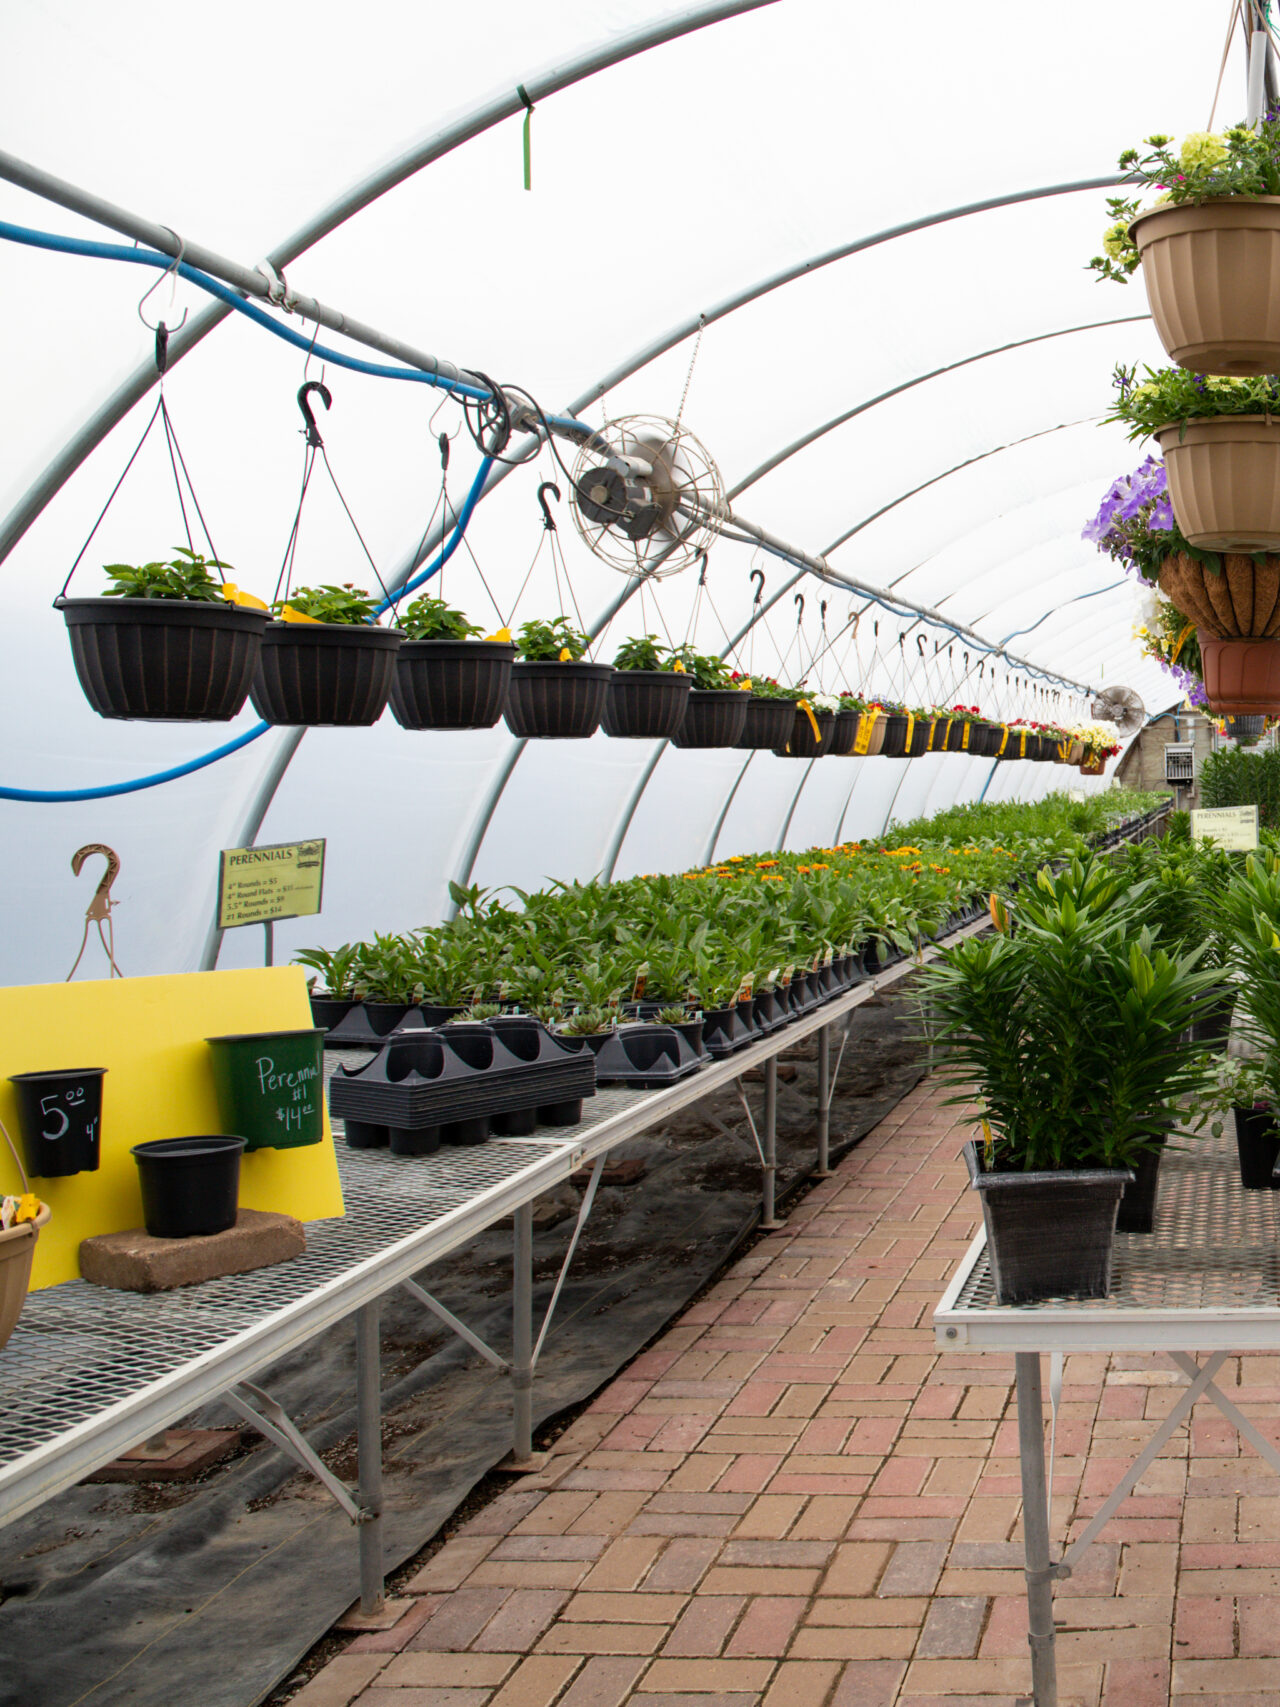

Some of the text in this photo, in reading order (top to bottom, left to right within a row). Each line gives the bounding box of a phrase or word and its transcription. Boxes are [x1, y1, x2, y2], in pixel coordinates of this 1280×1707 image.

[230, 849, 293, 866] PERENNIALS
[237, 880, 261, 889] Rounds
[237, 889, 258, 899] Round
[243, 898, 268, 908] Rounds
[237, 909, 262, 919] Rounds
[292, 1083, 307, 1101] #1
